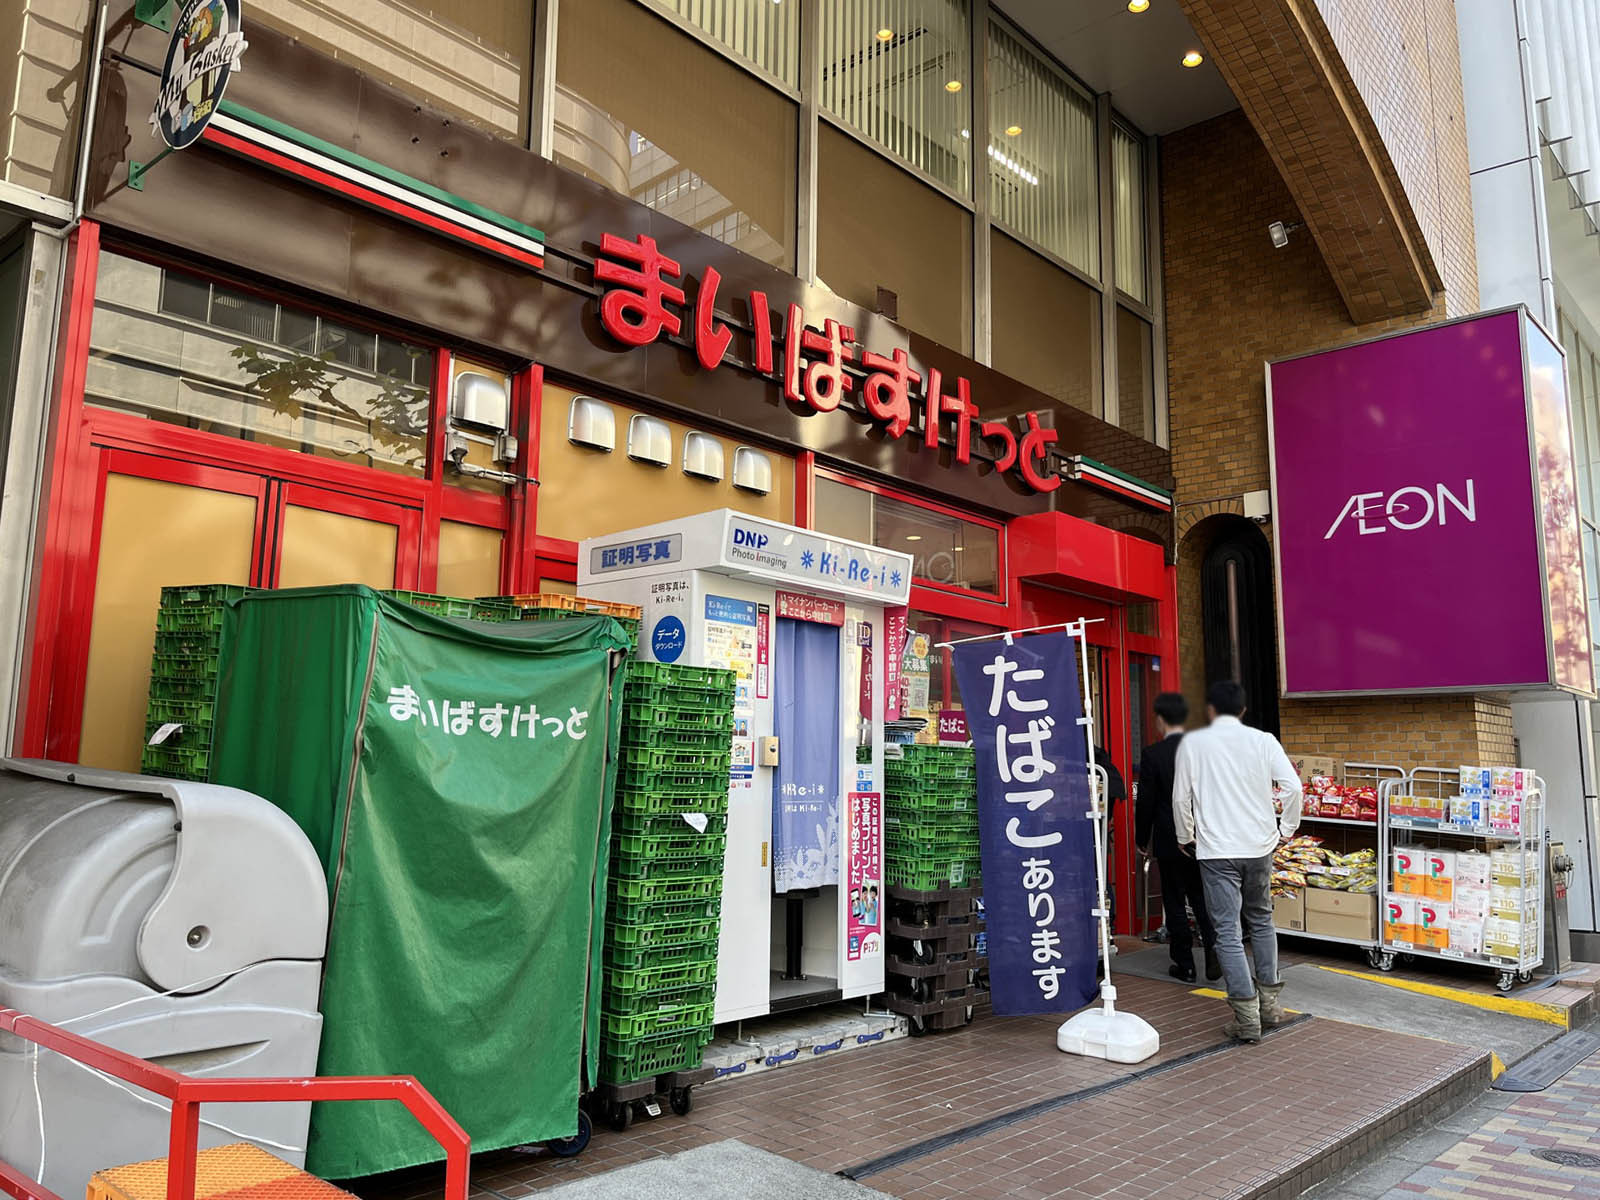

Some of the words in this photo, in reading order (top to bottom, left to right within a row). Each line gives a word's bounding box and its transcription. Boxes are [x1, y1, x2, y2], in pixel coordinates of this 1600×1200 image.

[154, 74, 183, 113] My
[188, 35, 239, 81] Basket
[595, 232, 1062, 493] まいばすけっと
[601, 540, 671, 568] 証明写真
[733, 528, 769, 549] DNP
[732, 547, 755, 561] Photo
[756, 551, 787, 569] Imaging
[819, 551, 886, 586] Ki-Re-i
[655, 641, 683, 651] ダウンロード
[657, 627, 680, 641] データ
[386, 685, 589, 740] まいばすけっと
[939, 717, 966, 734] たばこ
[851, 797, 860, 885] はじめました
[861, 797, 871, 883] 写真プリント
